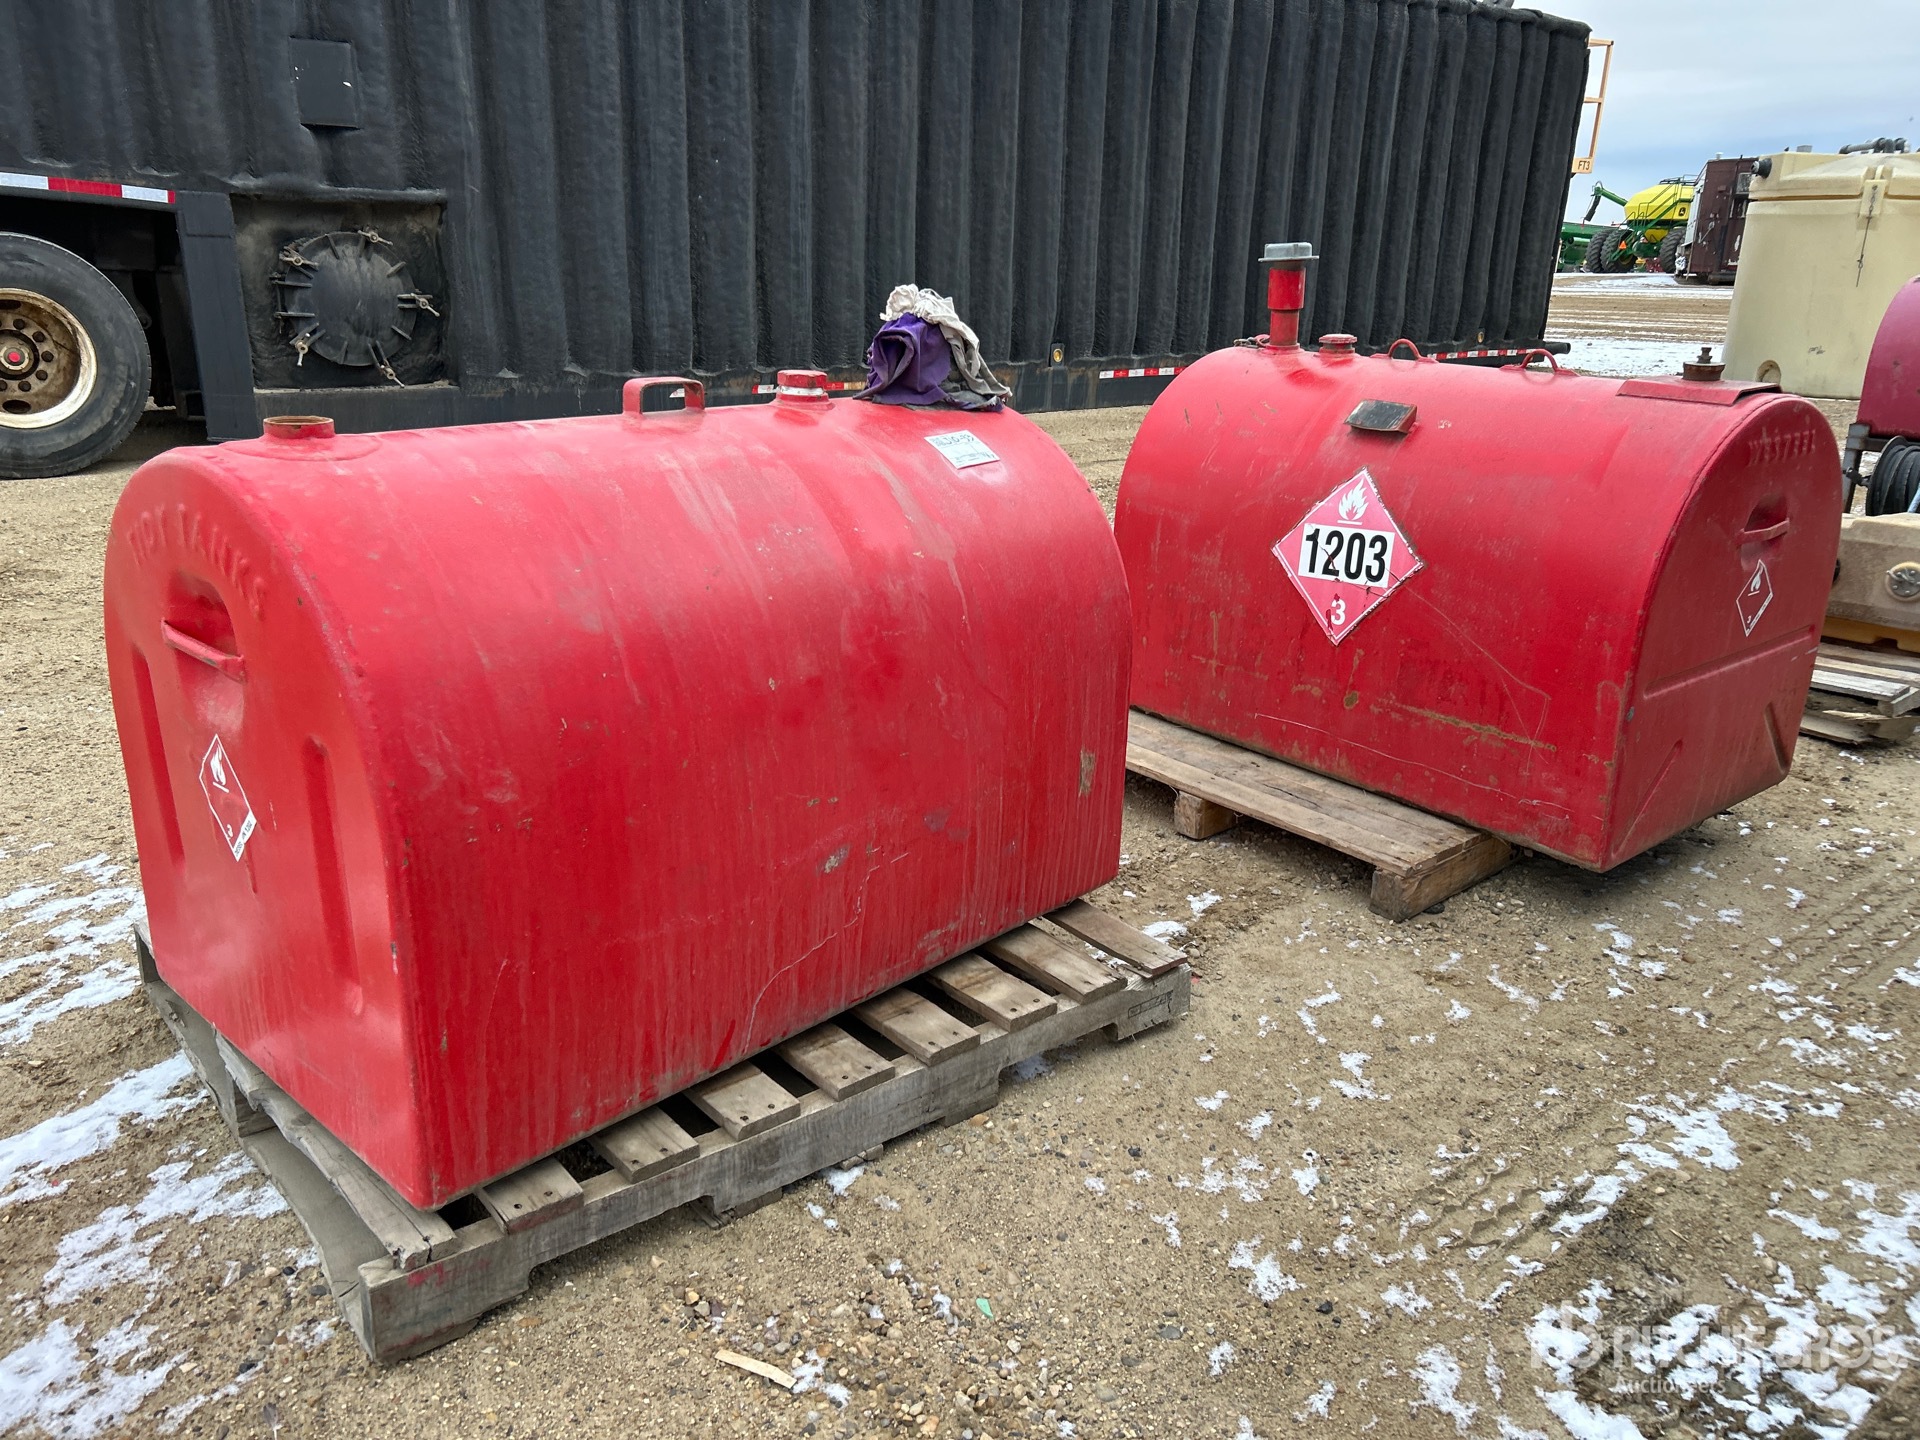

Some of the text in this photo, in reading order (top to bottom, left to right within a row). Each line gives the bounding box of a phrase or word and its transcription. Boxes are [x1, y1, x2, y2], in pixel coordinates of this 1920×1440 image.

[1577, 160, 1591, 171] FT3
[1305, 527, 1389, 583] 1203
[1330, 598, 1347, 626] 3
[226, 823, 234, 840] 3
